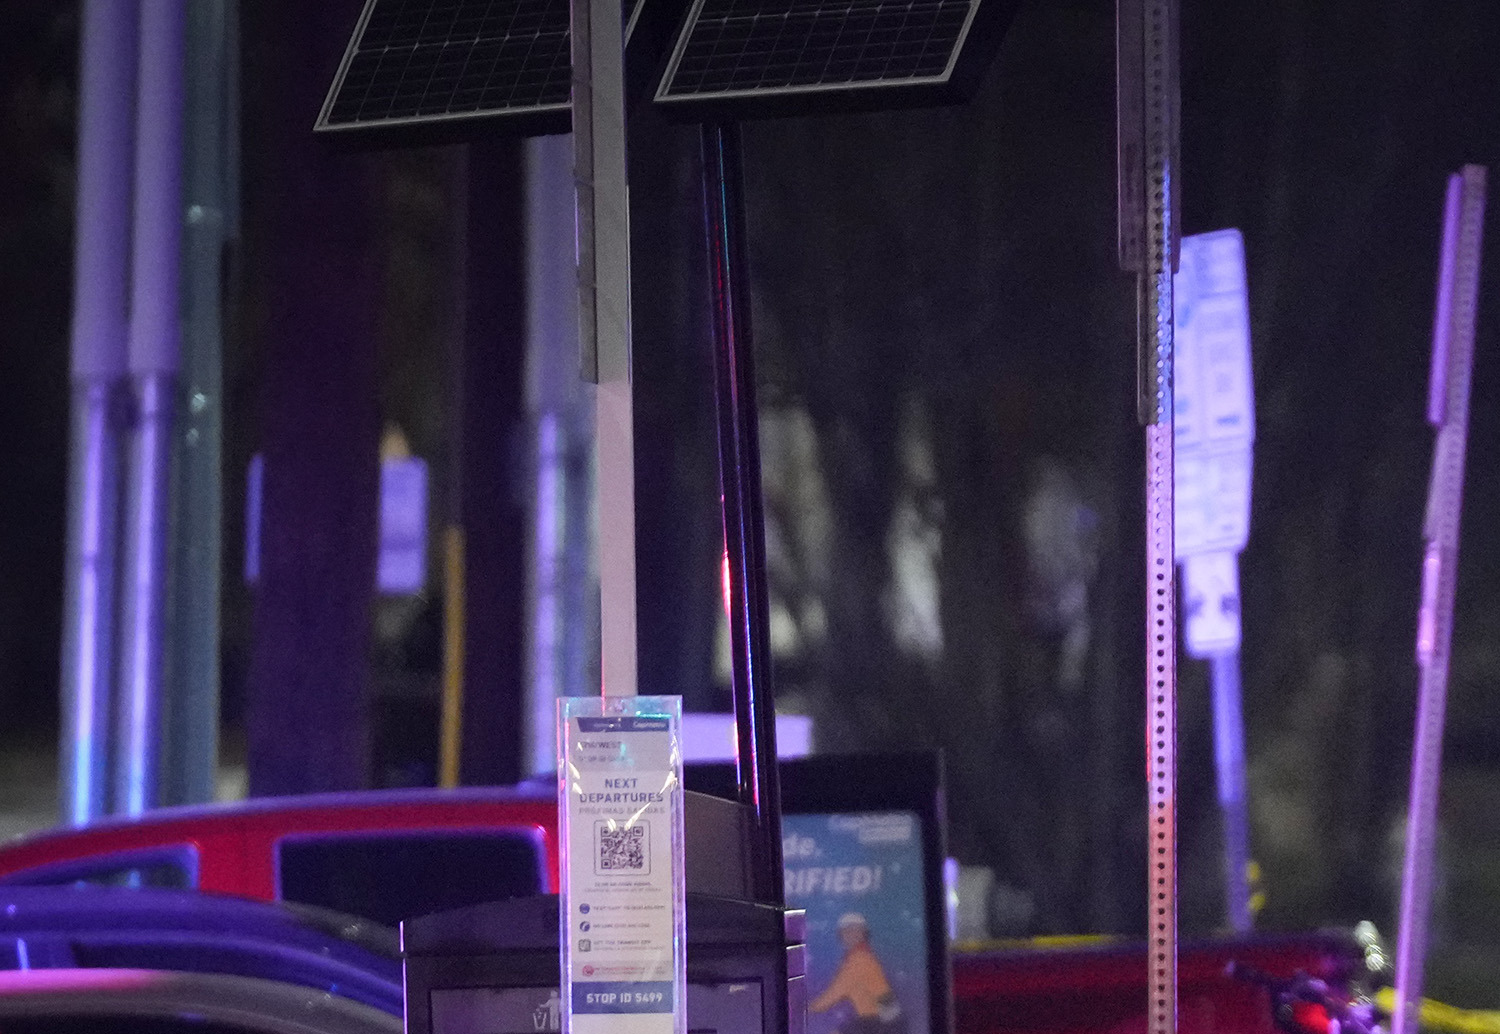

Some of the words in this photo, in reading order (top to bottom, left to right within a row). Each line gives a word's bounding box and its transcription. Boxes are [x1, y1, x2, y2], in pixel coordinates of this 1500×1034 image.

[605, 778, 638, 789] NEXT
[579, 792, 664, 803] DEPARTURES
[586, 992, 617, 1004] STOP
[620, 992, 632, 1004] ID
